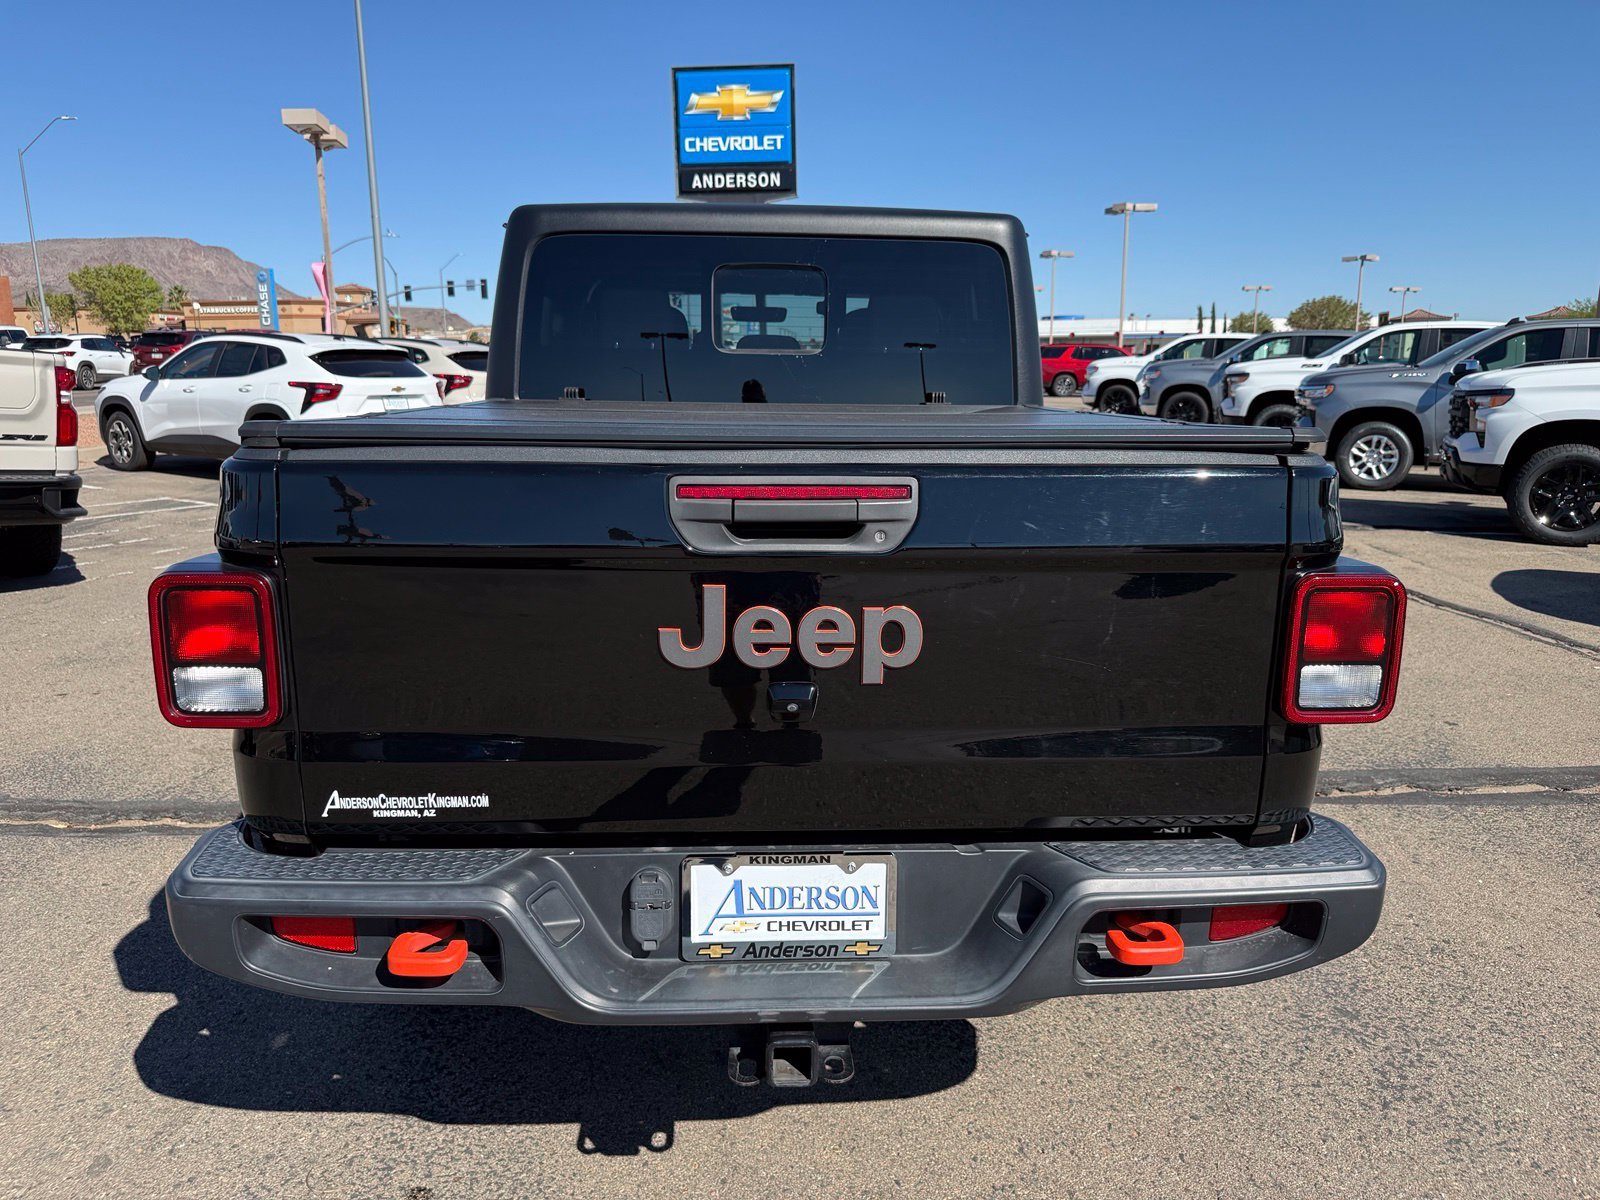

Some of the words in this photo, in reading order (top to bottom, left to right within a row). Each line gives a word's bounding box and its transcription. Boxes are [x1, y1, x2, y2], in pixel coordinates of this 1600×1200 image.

[684, 135, 784, 152] CHEVROLET
[692, 171, 781, 189] ANDERSON
[199, 306, 235, 314] STARBUCKS
[258, 283, 271, 326] CHASE
[658, 584, 923, 685] Jeep
[373, 809, 422, 818] KINGMAN,
[423, 809, 436, 817] AZ
[749, 855, 832, 865] KINGMAN
[698, 879, 881, 937] ANDERSON
[766, 919, 874, 933] CHEVROLET
[741, 942, 839, 959] Anderson
